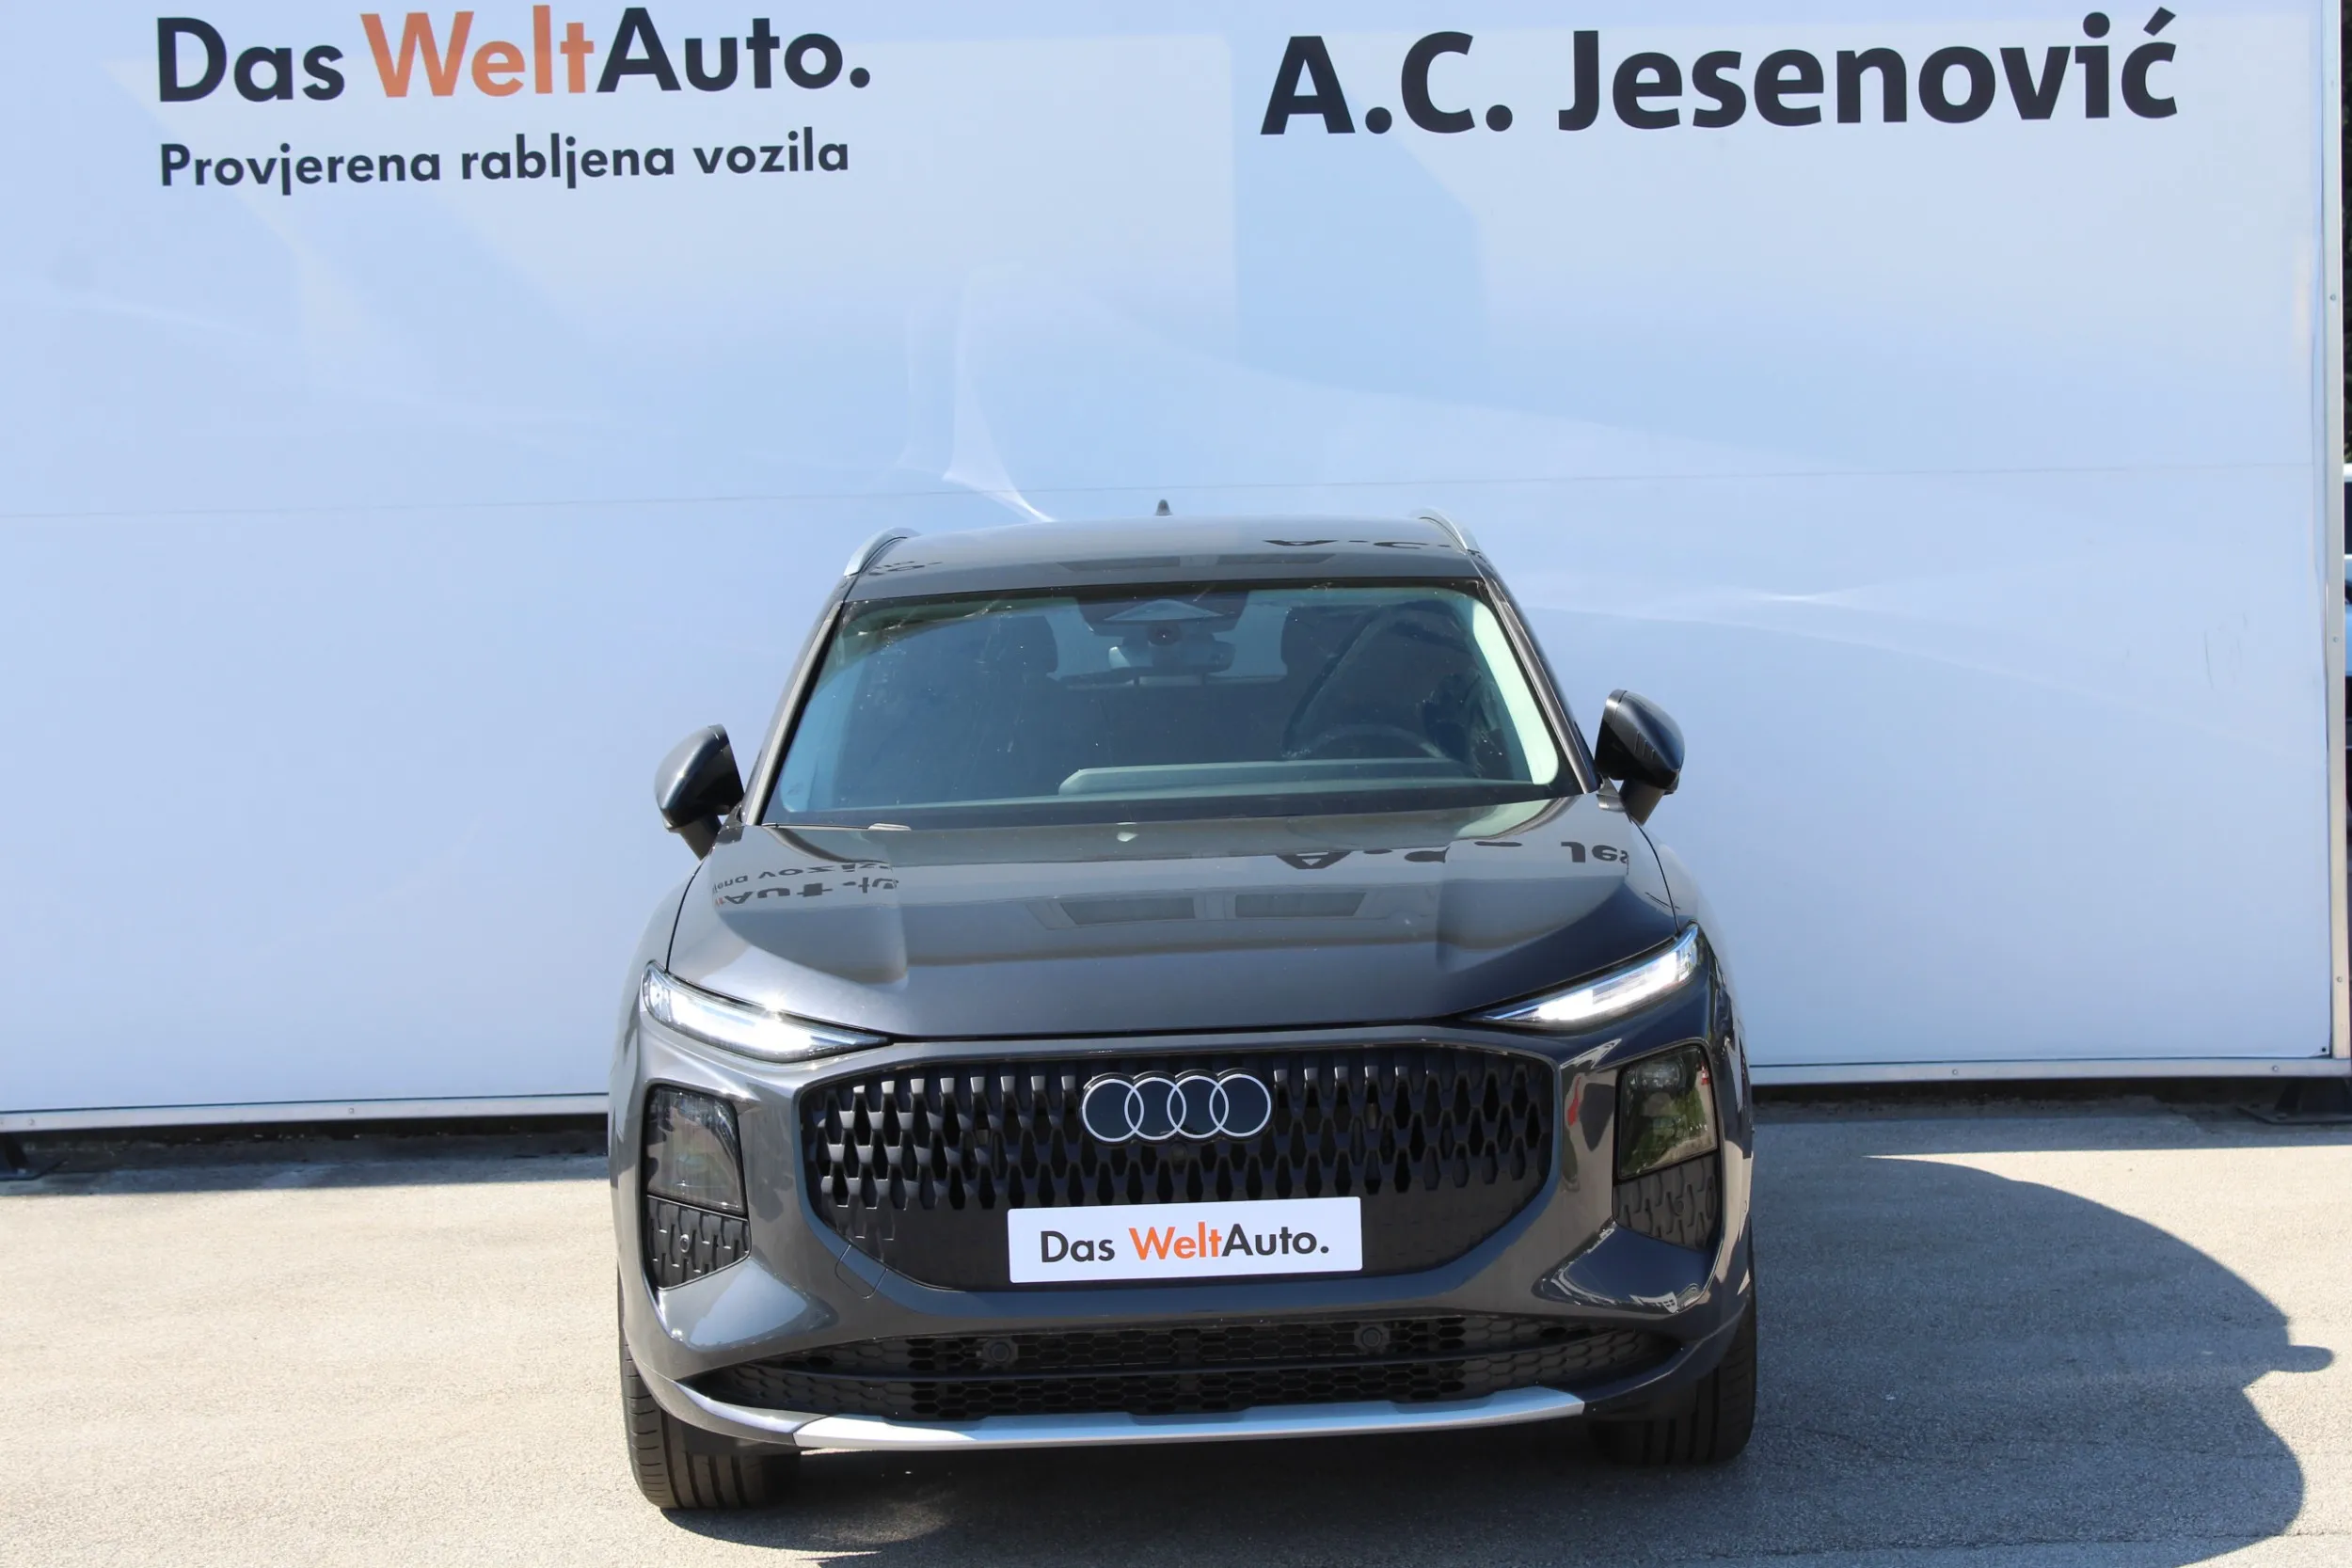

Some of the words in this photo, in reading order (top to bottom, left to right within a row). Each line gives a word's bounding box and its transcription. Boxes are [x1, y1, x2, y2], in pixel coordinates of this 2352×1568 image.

[157, 17, 345, 103] Das
[360, 6, 871, 98] WeltAuto.
[1261, 31, 1514, 135] A.C.
[1559, 8, 2178, 132] Jesenović
[161, 143, 441, 197] Provjerena
[462, 134, 675, 190] rabljena
[693, 127, 850, 174] vozila
[1041, 1230, 1117, 1263] Das
[1129, 1222, 1329, 1260] WeltAuto.
